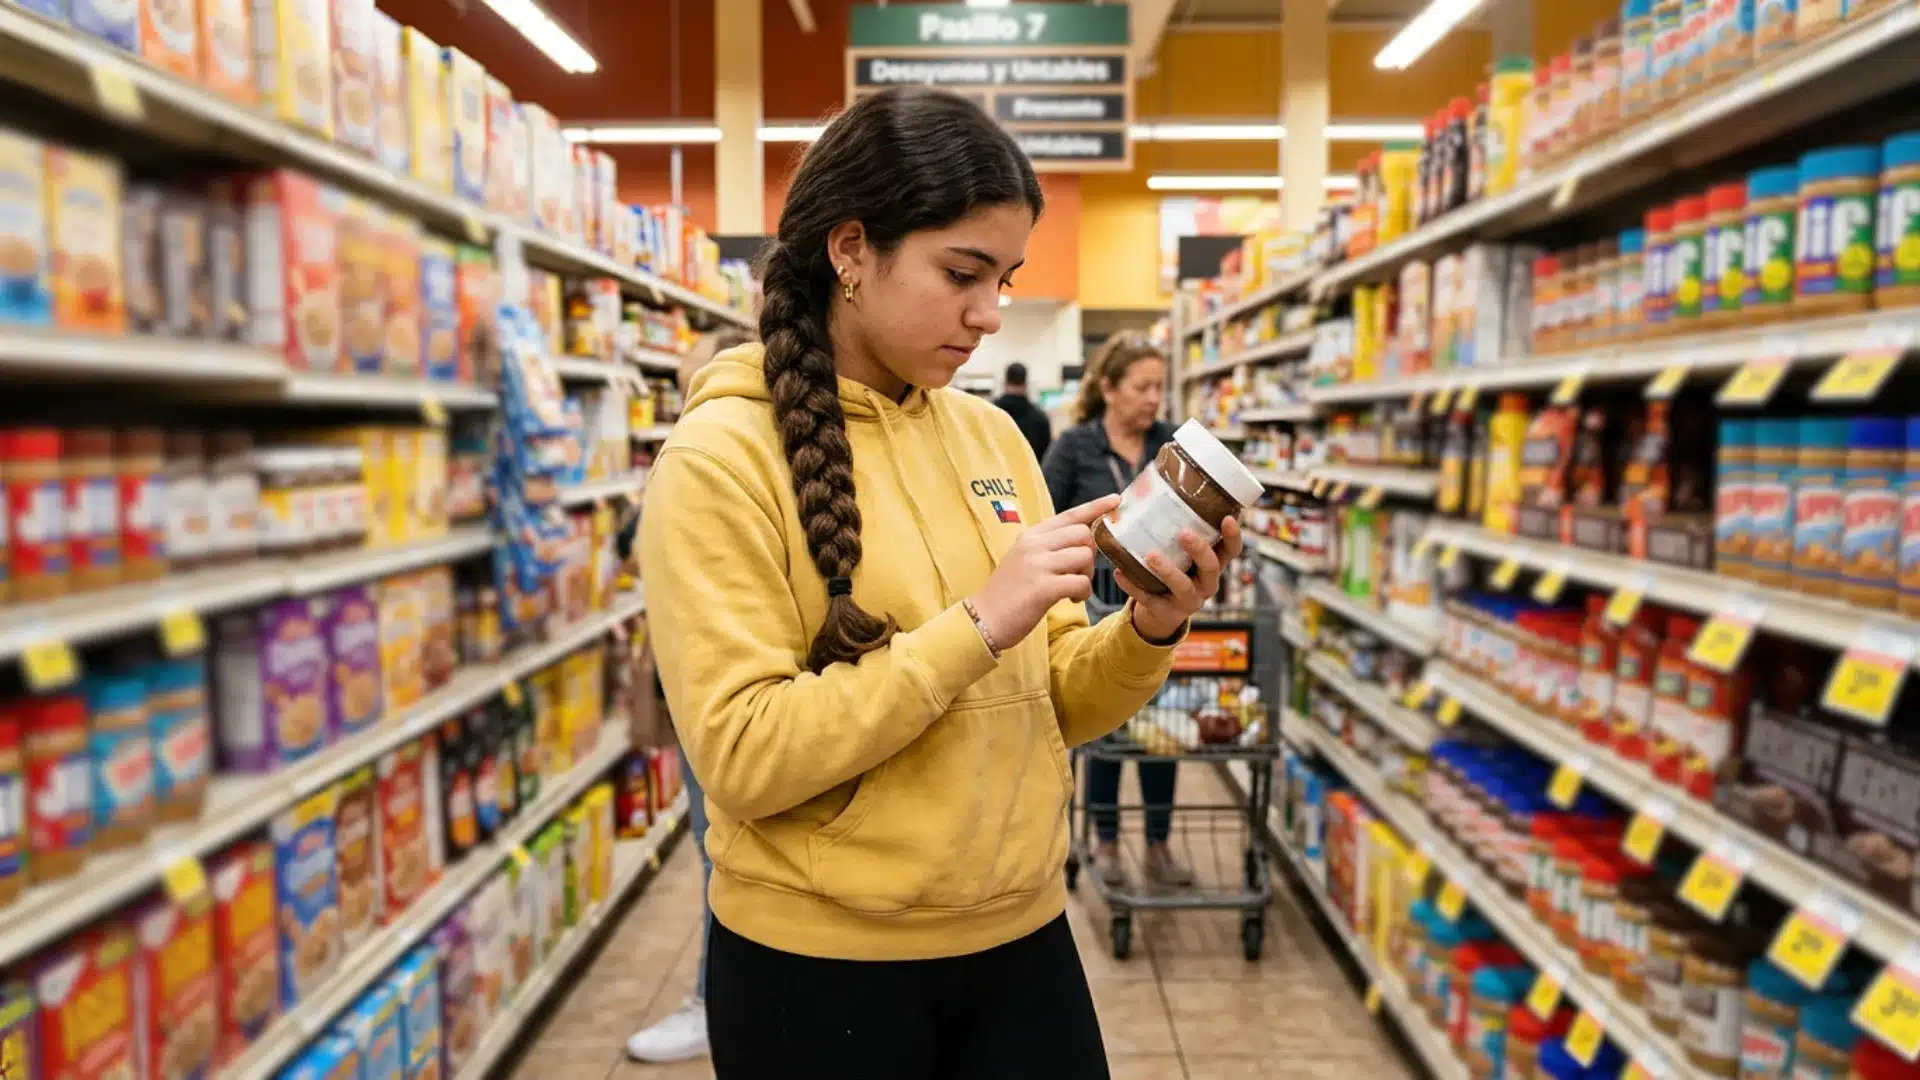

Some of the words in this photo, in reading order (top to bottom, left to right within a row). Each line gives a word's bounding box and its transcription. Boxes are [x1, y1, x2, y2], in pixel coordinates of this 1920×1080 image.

[919, 13, 1019, 41] Pasillo
[1026, 13, 1047, 40] 7
[992, 63, 1007, 84] y
[970, 478, 1017, 498] CHILE
